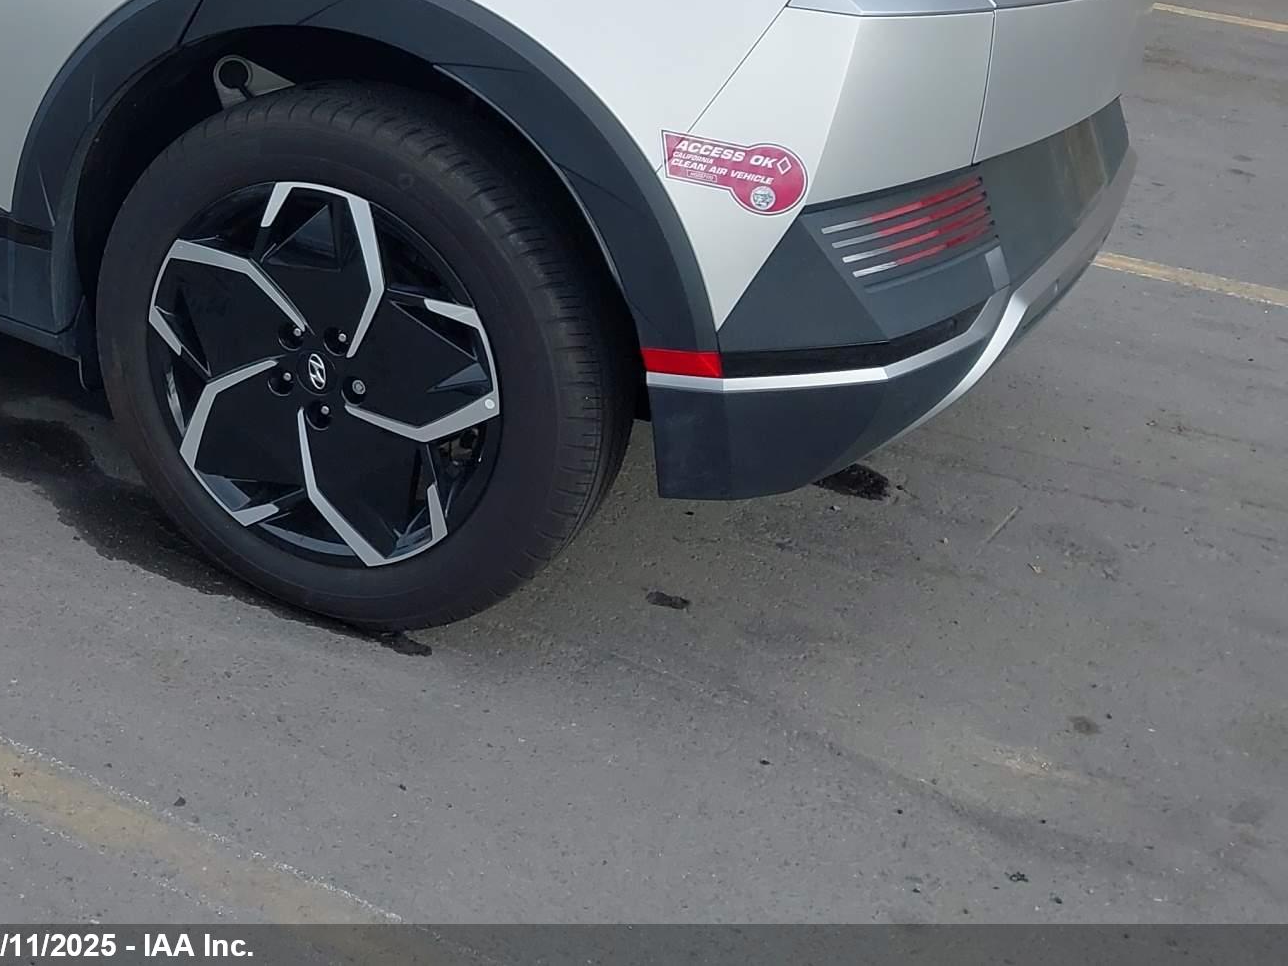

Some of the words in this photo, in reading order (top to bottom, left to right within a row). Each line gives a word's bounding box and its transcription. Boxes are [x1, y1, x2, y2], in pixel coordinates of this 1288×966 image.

[672, 151, 715, 165] CALIFORNIA
[675, 139, 746, 162] ACCESS
[749, 154, 778, 169] OK
[670, 158, 708, 172] CLEAN
[708, 166, 728, 176] AIR
[730, 170, 775, 185] VEHICLE
